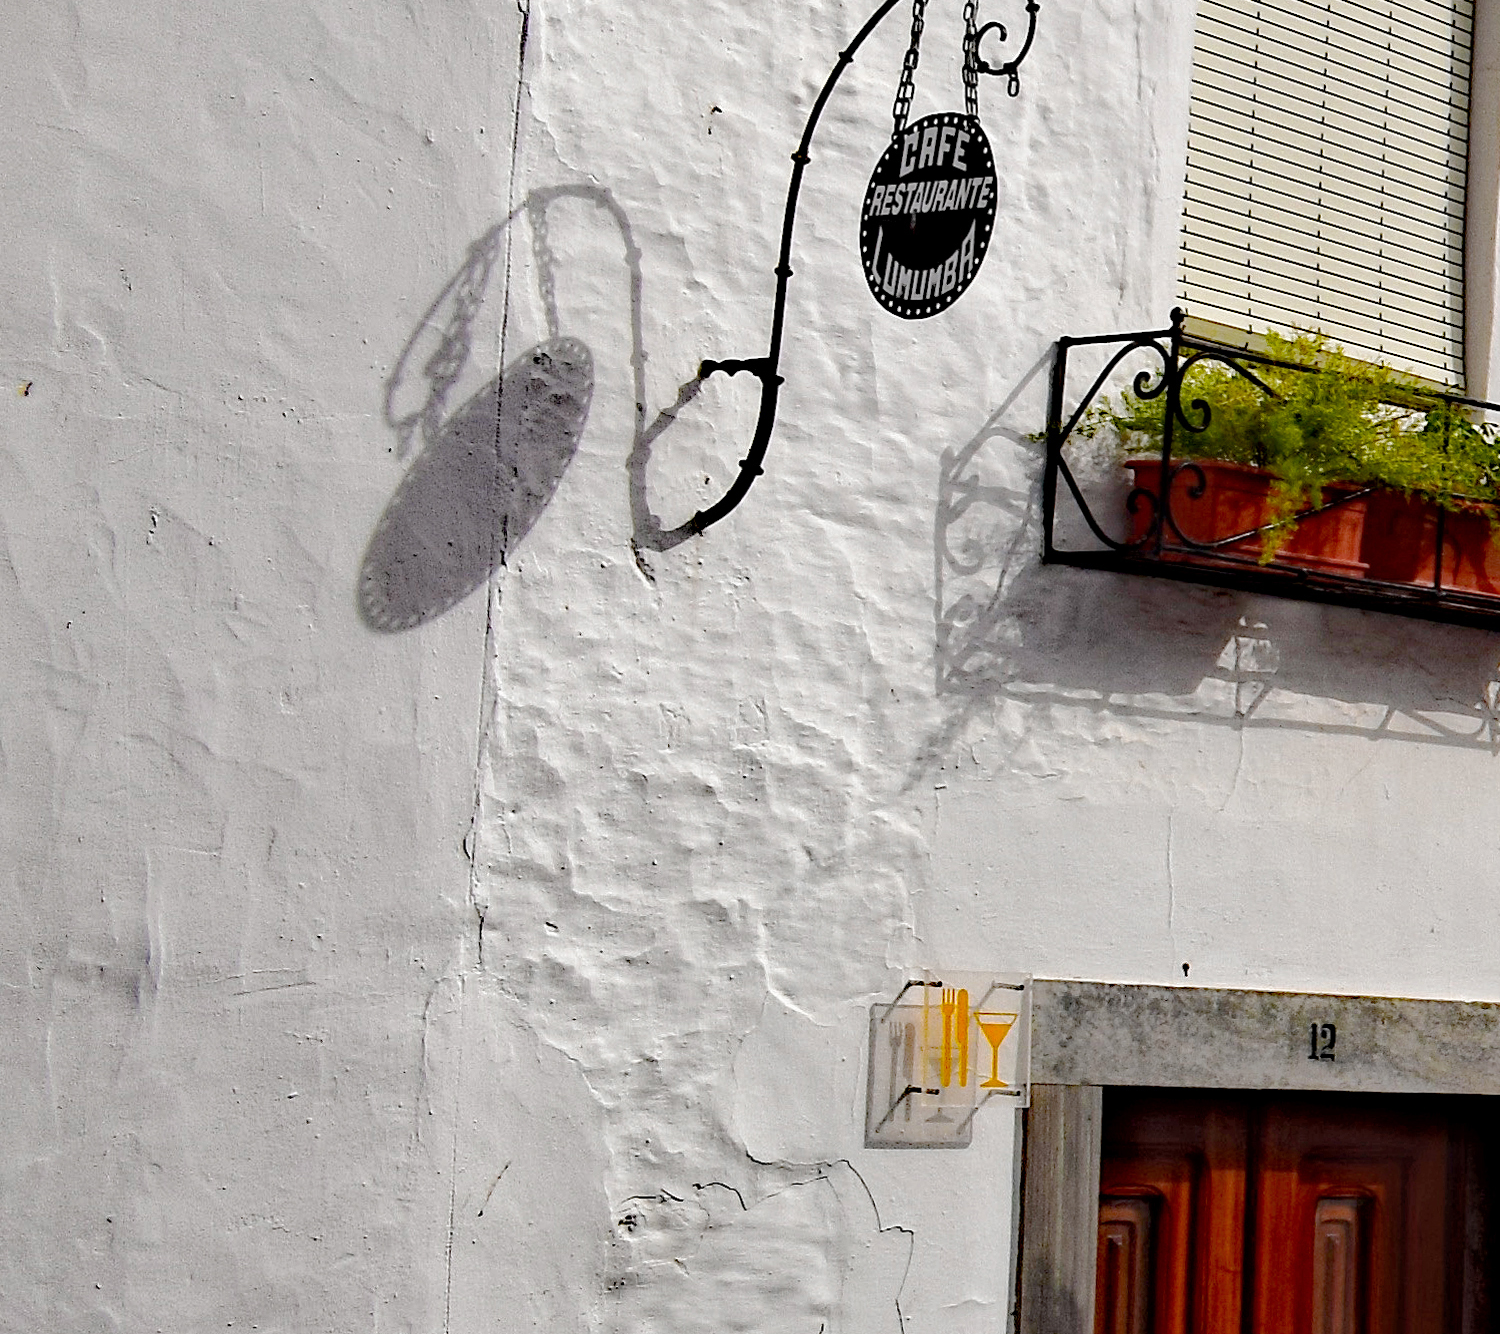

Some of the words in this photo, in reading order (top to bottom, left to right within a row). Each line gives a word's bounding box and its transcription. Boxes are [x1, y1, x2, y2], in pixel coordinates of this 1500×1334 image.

[869, 176, 993, 216] RESTAURANTE
[872, 218, 976, 301] LUMUMBA
[1308, 1023, 1336, 1062] 12
